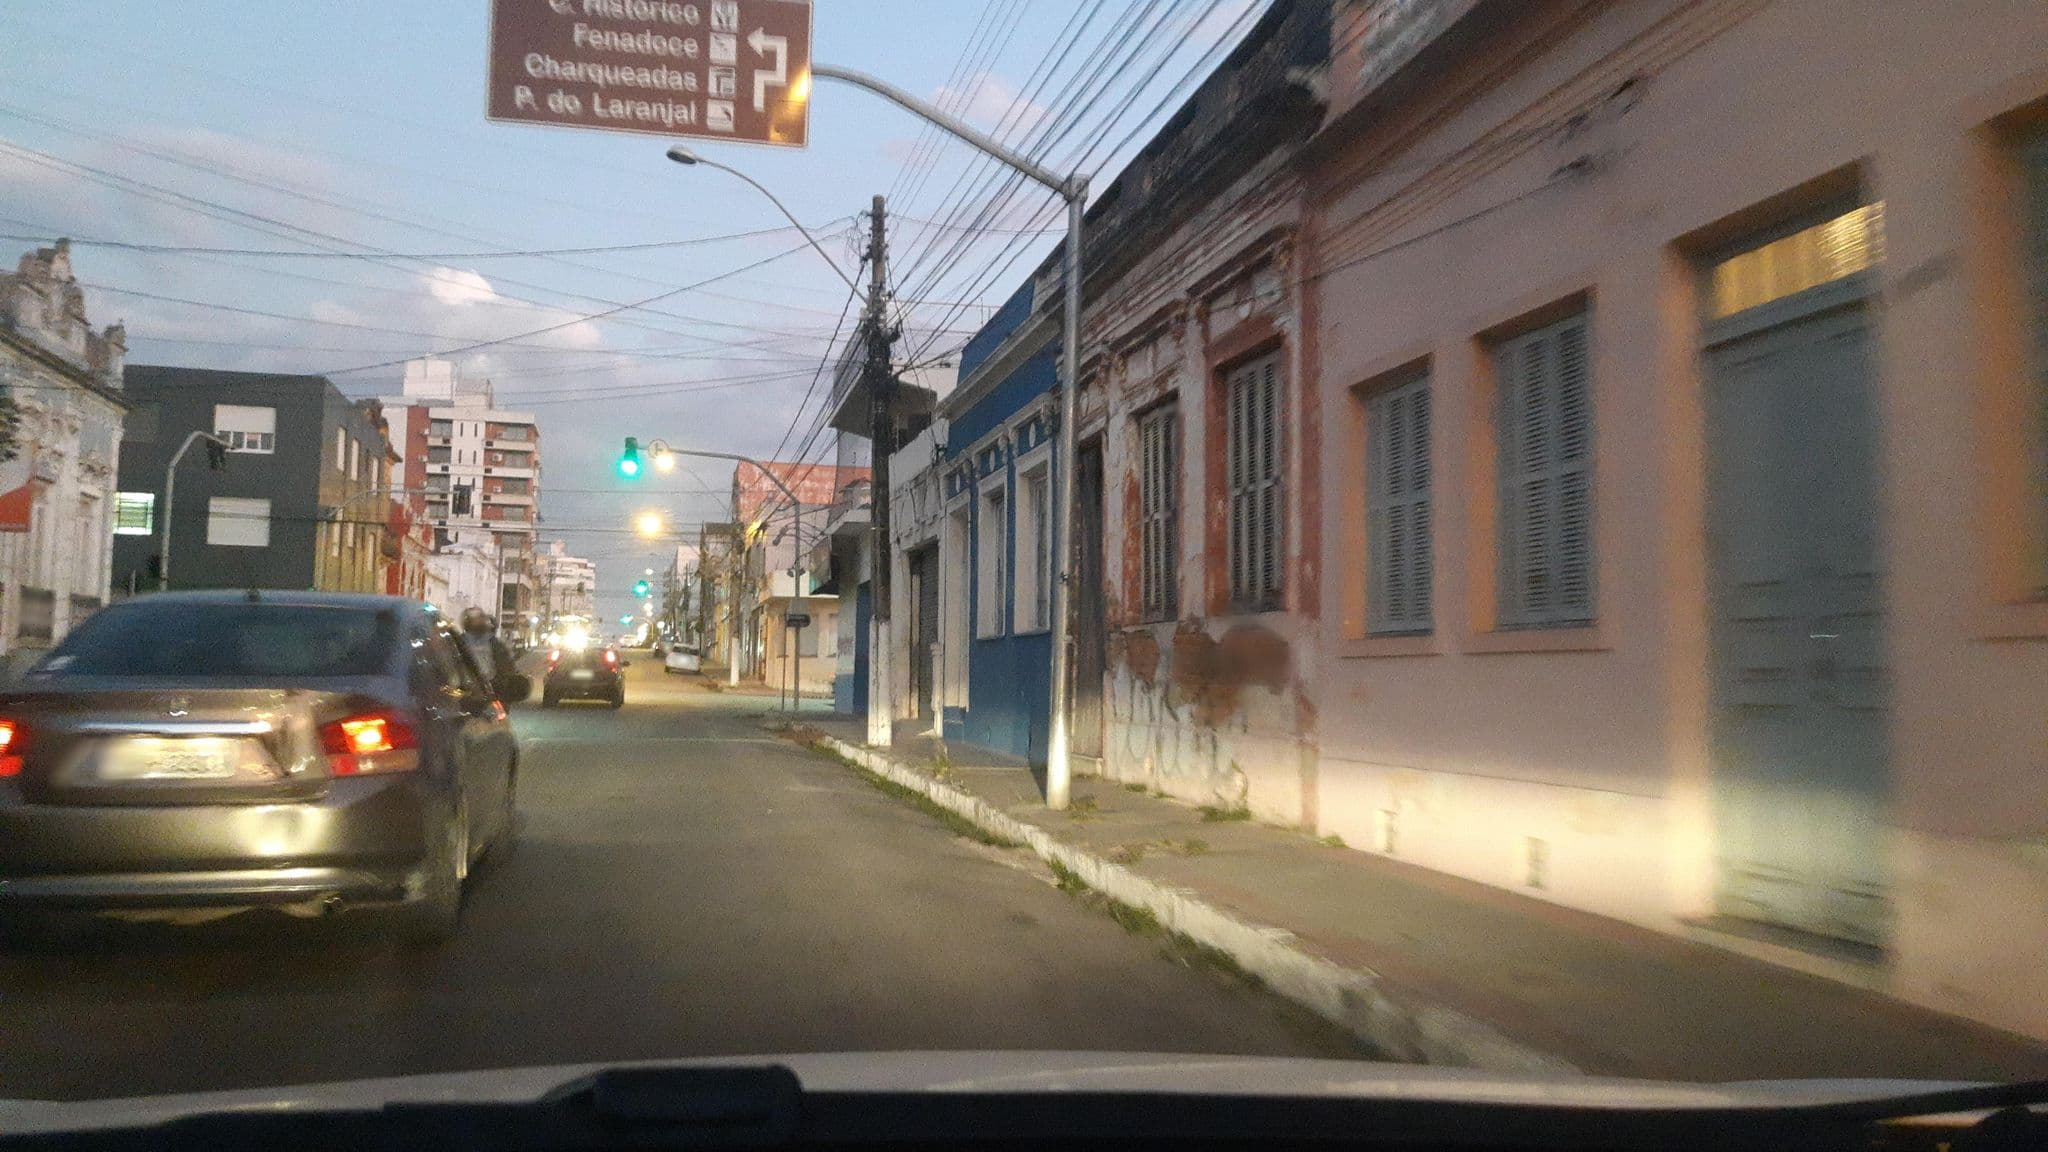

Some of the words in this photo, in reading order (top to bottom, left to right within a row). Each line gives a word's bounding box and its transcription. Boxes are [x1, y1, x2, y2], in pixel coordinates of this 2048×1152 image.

[574, 22, 699, 59] Fenadoce
[525, 53, 698, 92] Charqueadas
[548, 89, 582, 114] do
[592, 92, 697, 127] Laranjal
